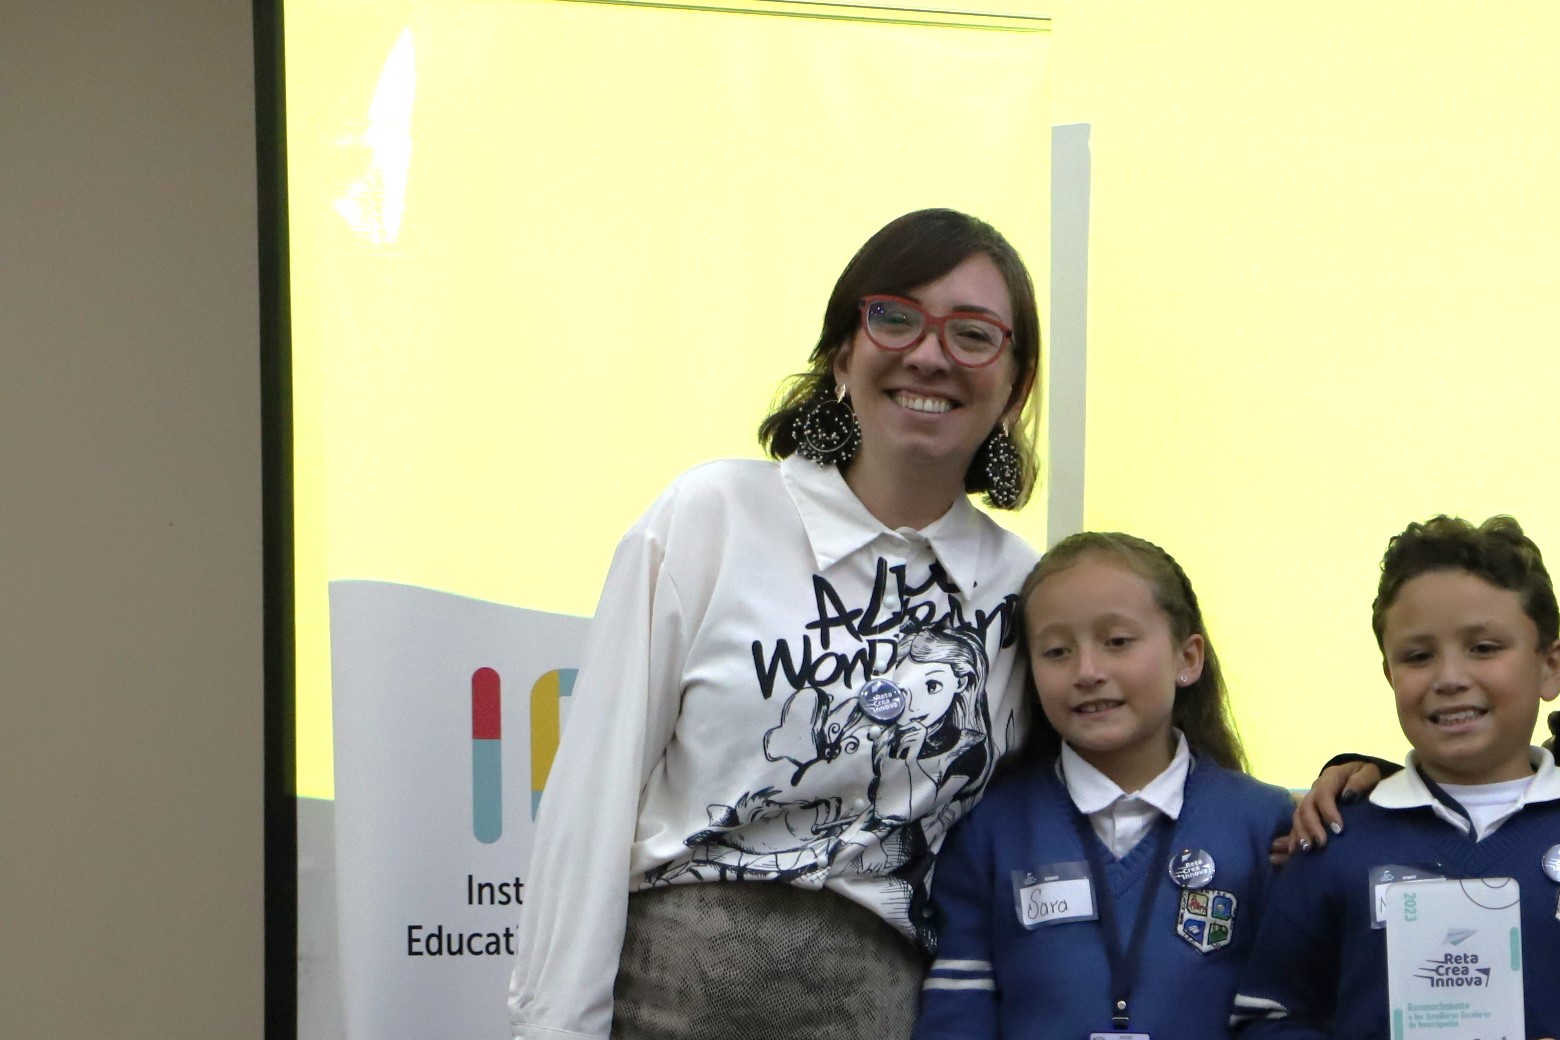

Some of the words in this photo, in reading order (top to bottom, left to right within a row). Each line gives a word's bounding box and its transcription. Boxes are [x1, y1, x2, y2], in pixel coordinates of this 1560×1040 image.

[875, 692, 893, 700] Reta
[873, 699, 891, 707] Crea
[873, 702, 898, 713] Innova
[1183, 865, 1200, 874] Crea
[1185, 859, 1203, 869] Reta
[1181, 868, 1208, 881] Innova
[1028, 888, 1068, 920] Sara
[1403, 892, 1418, 922] 2023
[407, 924, 520, 957] Educat
[1444, 953, 1479, 965] Reta
[1435, 964, 1470, 977] Crea
[1430, 976, 1483, 988] Innova
